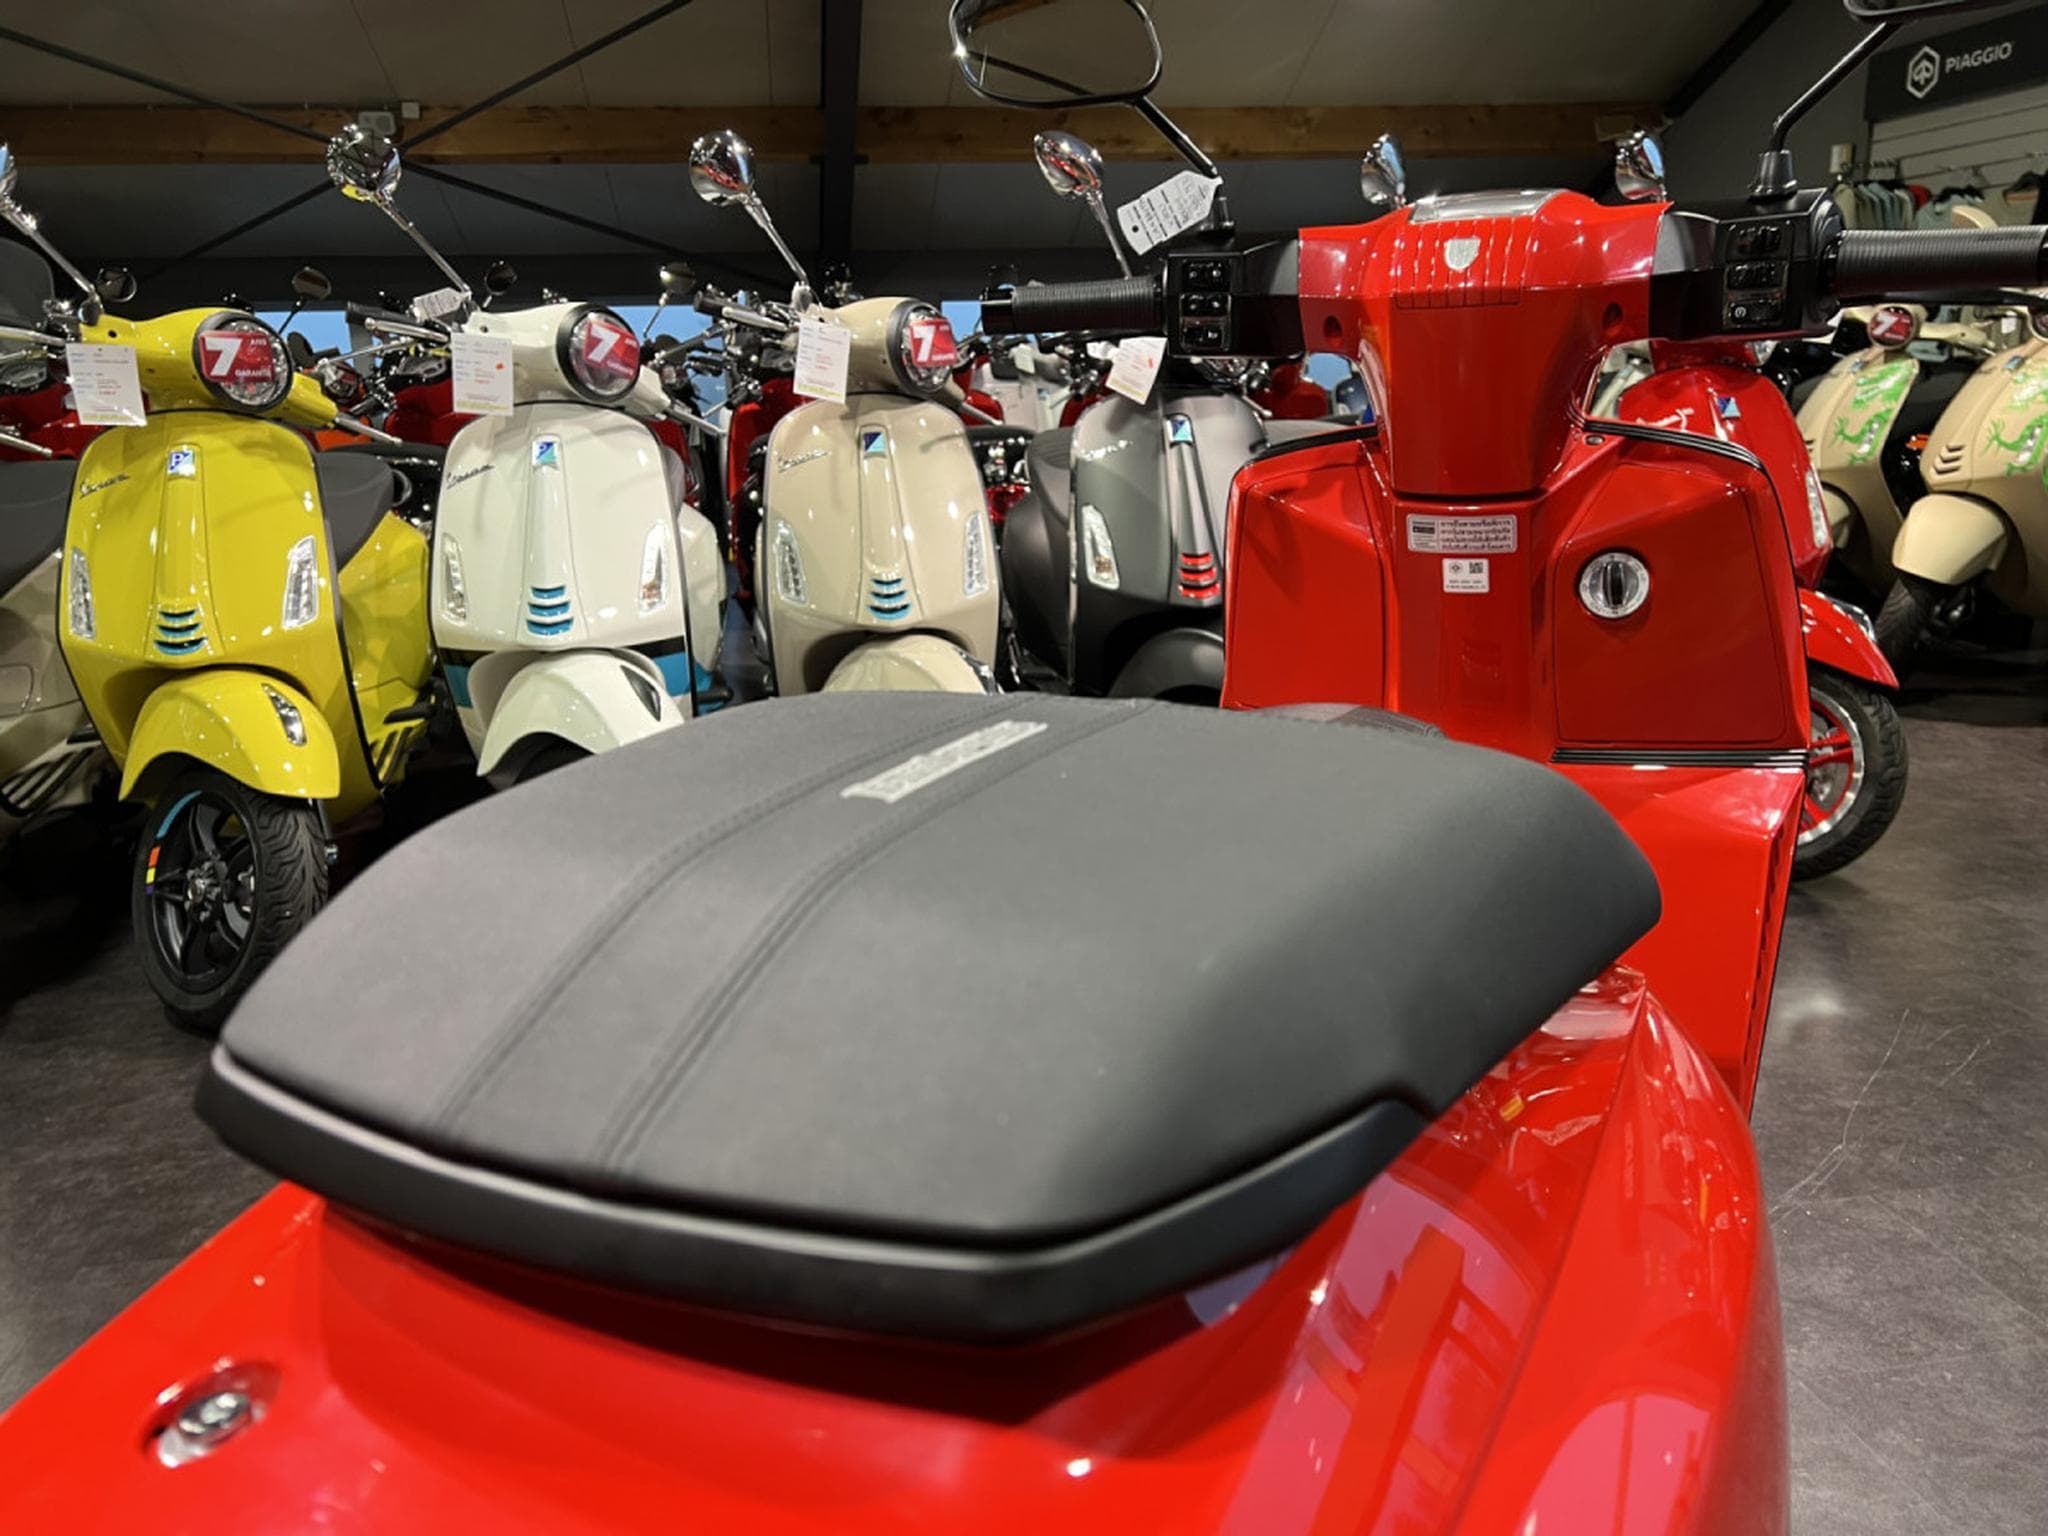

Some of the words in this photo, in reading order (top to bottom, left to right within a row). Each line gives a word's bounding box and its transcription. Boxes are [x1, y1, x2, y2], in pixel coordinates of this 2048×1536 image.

[1945, 42, 2012, 74] PIAGGIO
[204, 336, 243, 376] 7
[587, 323, 620, 362] 7
[912, 325, 936, 362] 7
